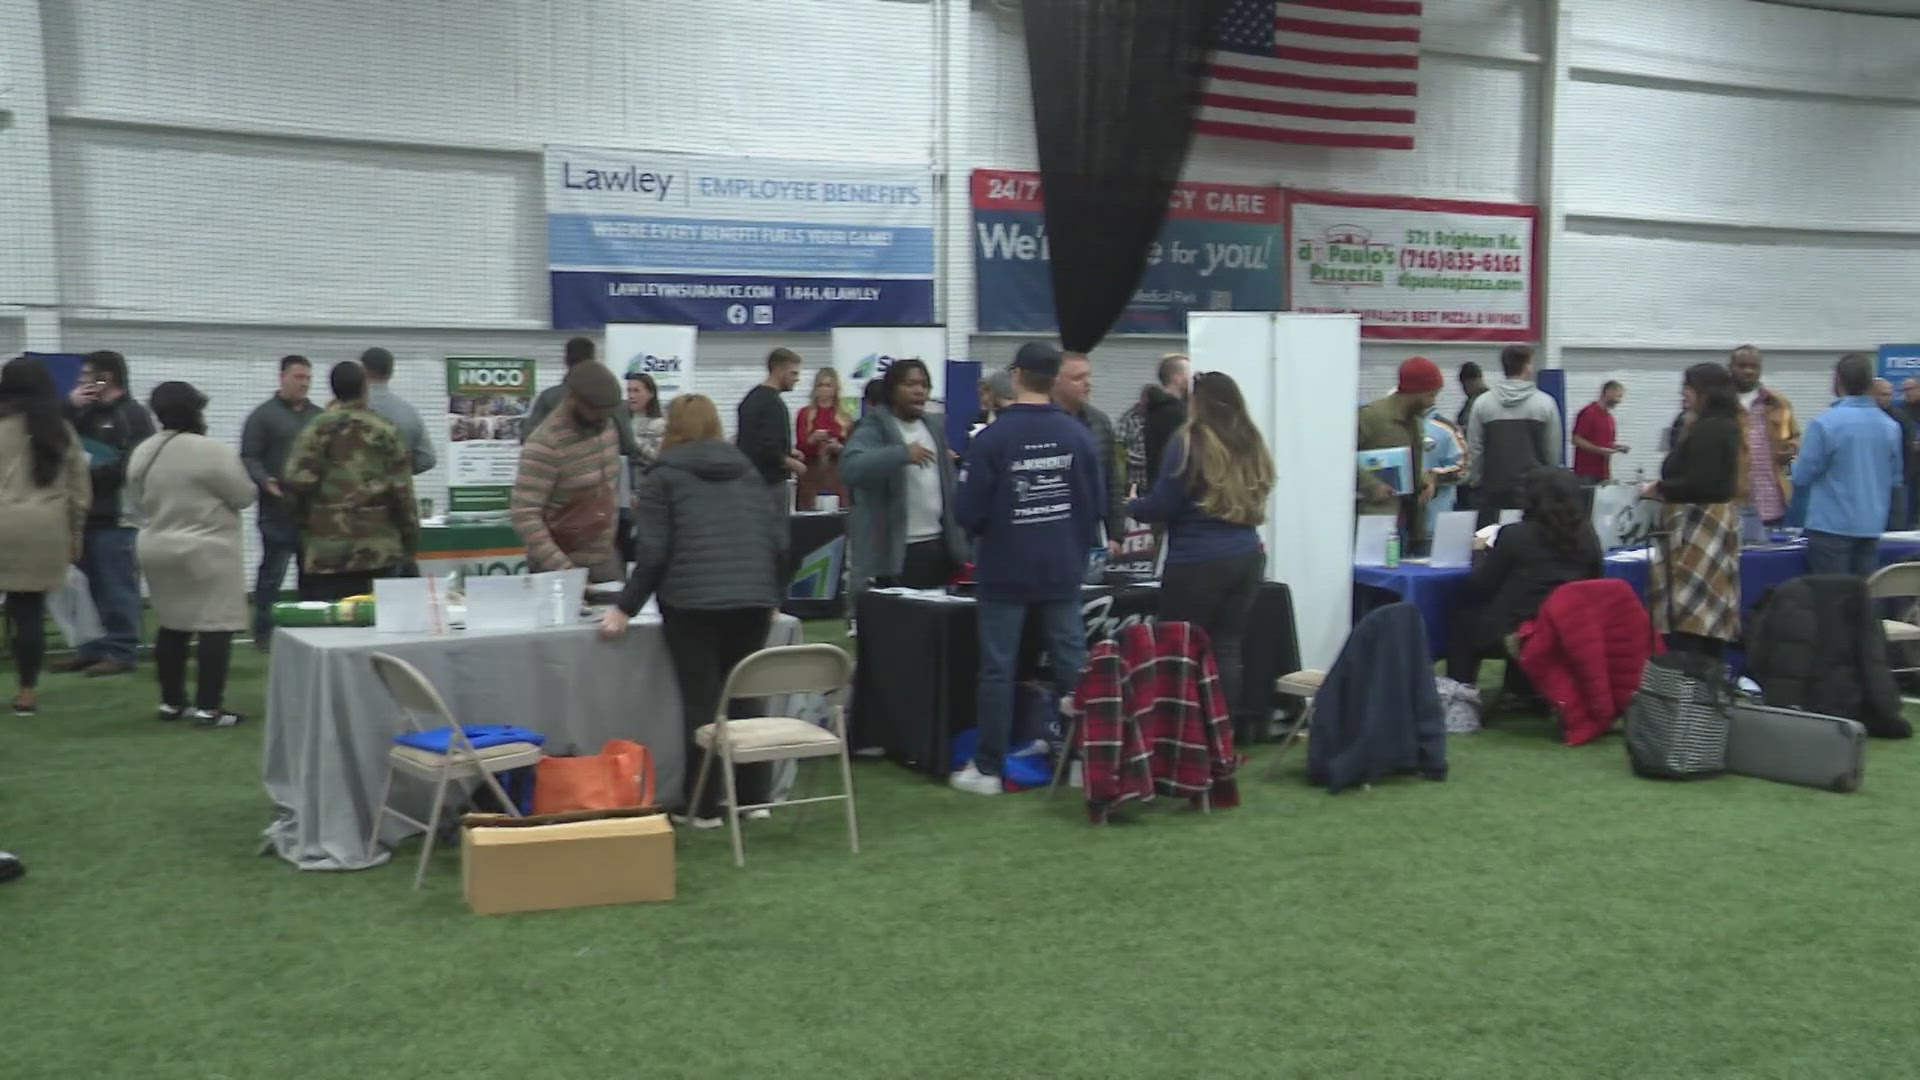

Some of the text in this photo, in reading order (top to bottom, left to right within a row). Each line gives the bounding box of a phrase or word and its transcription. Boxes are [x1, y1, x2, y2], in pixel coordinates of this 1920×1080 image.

[564, 161, 674, 202] Lawley
[700, 176, 921, 205] EMPLOYEE BENEFITS
[988, 178, 1041, 201] 24/7
[1205, 191, 1265, 215] CARE
[1168, 240, 1199, 264] for
[1198, 236, 1274, 276] you!
[1311, 263, 1384, 282] Pizzeria
[608, 282, 776, 299] LAWLEYINSURANCE.COM
[644, 353, 682, 373] Stark
